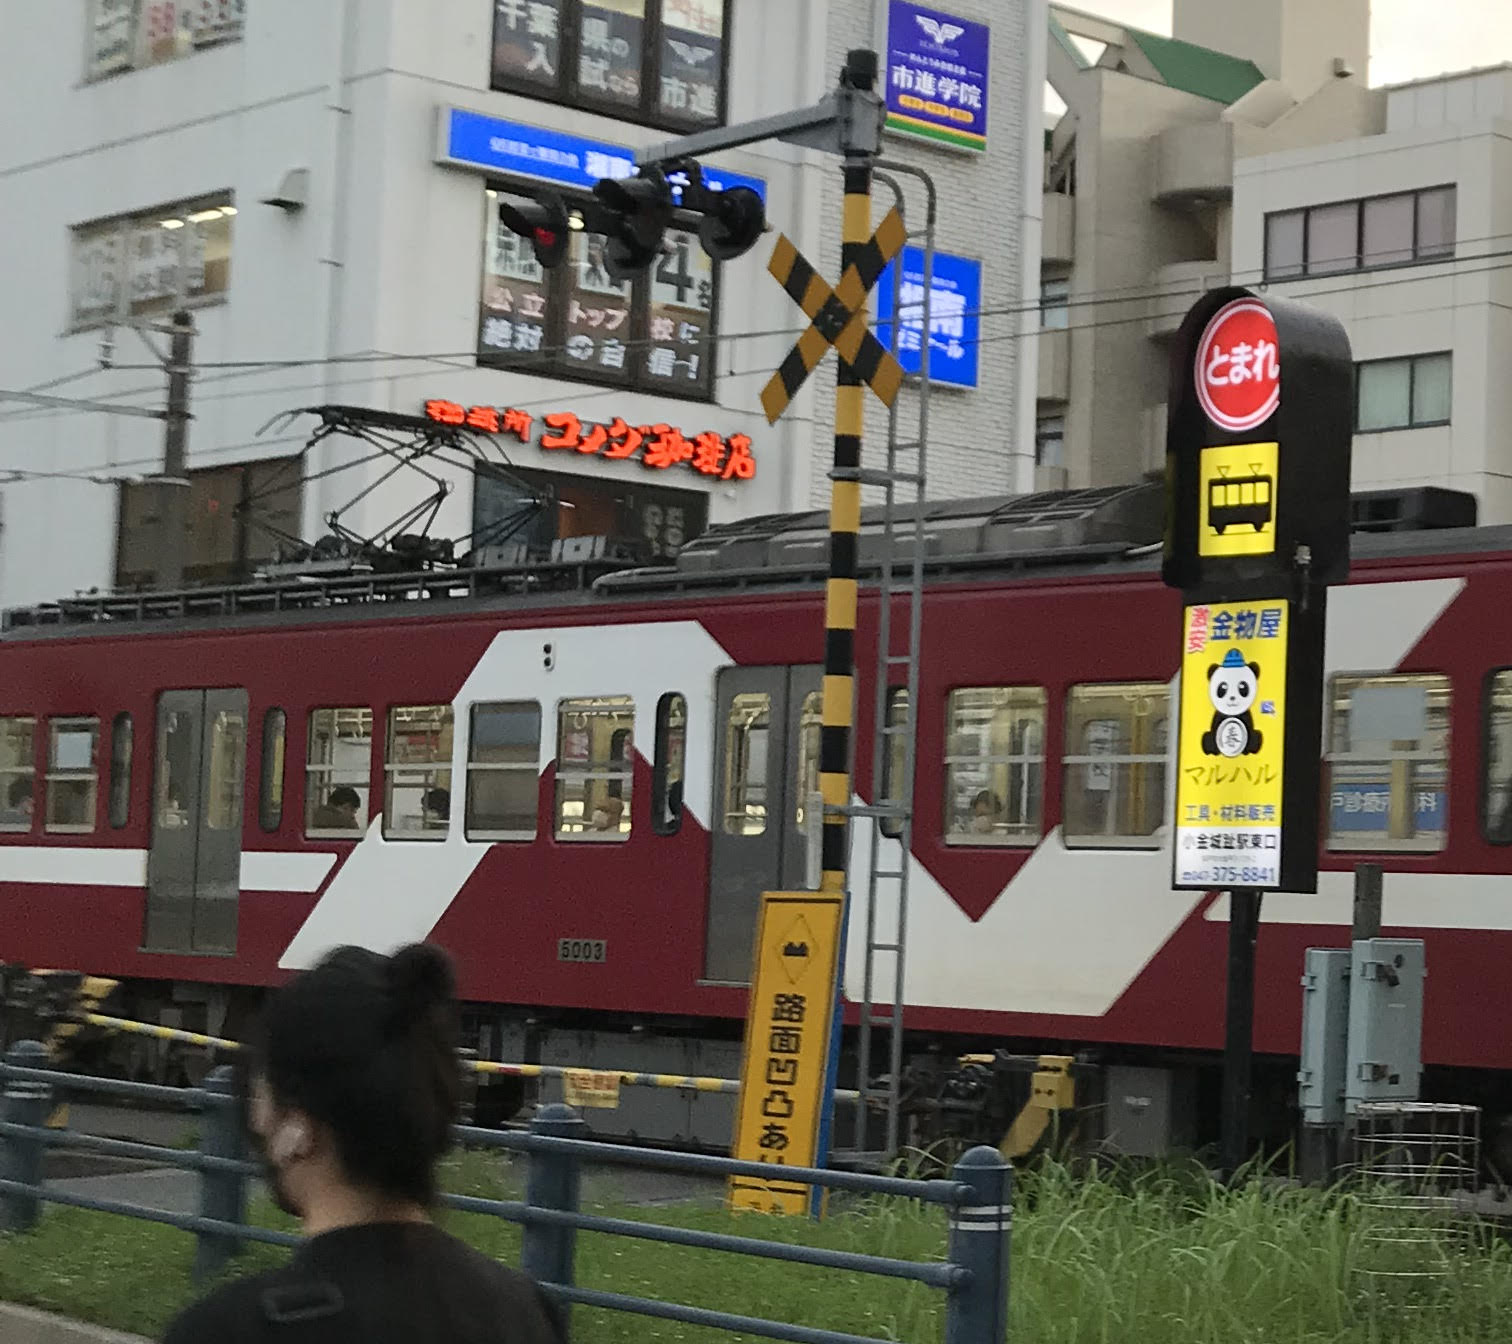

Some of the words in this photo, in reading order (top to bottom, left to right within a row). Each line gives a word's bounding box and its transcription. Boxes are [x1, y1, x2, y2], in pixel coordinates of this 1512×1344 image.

[891, 64, 982, 108] 市進学院
[1207, 339, 1280, 385] とまれ
[1210, 608, 1282, 640] 金物屋
[1185, 764, 1277, 787] マルハル
[562, 941, 603, 960] 5003
